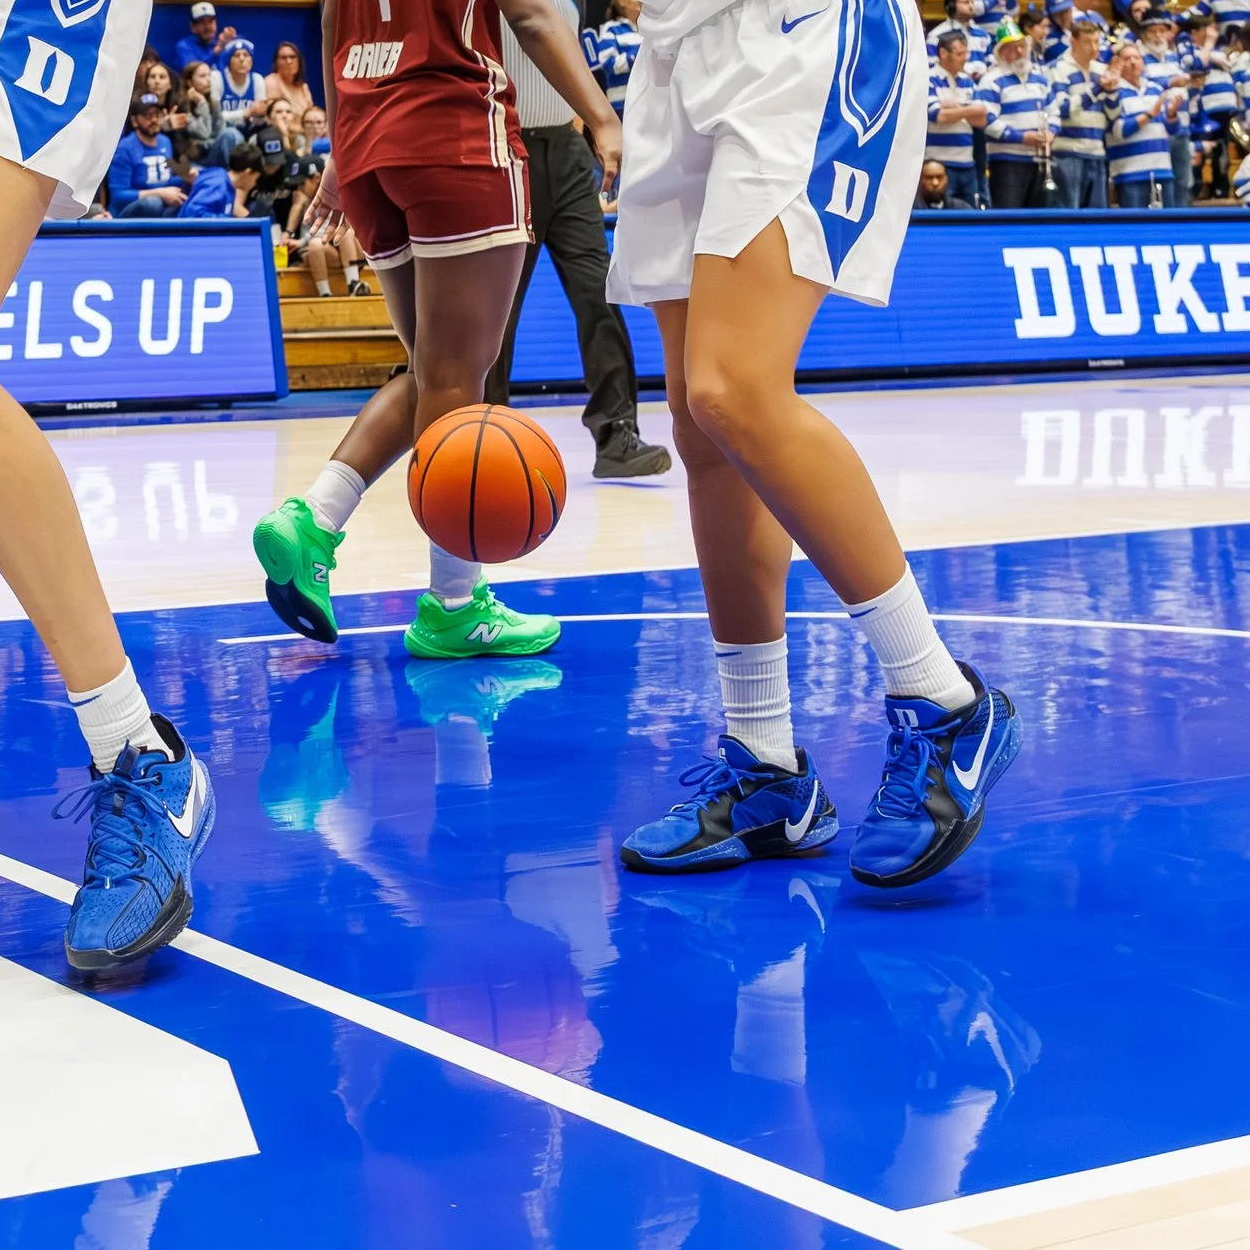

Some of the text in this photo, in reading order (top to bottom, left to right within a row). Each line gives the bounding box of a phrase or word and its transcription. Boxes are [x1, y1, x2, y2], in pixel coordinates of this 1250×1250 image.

[14, 36, 75, 106] D
[824, 160, 870, 223] D
[138, 277, 234, 355] UP
